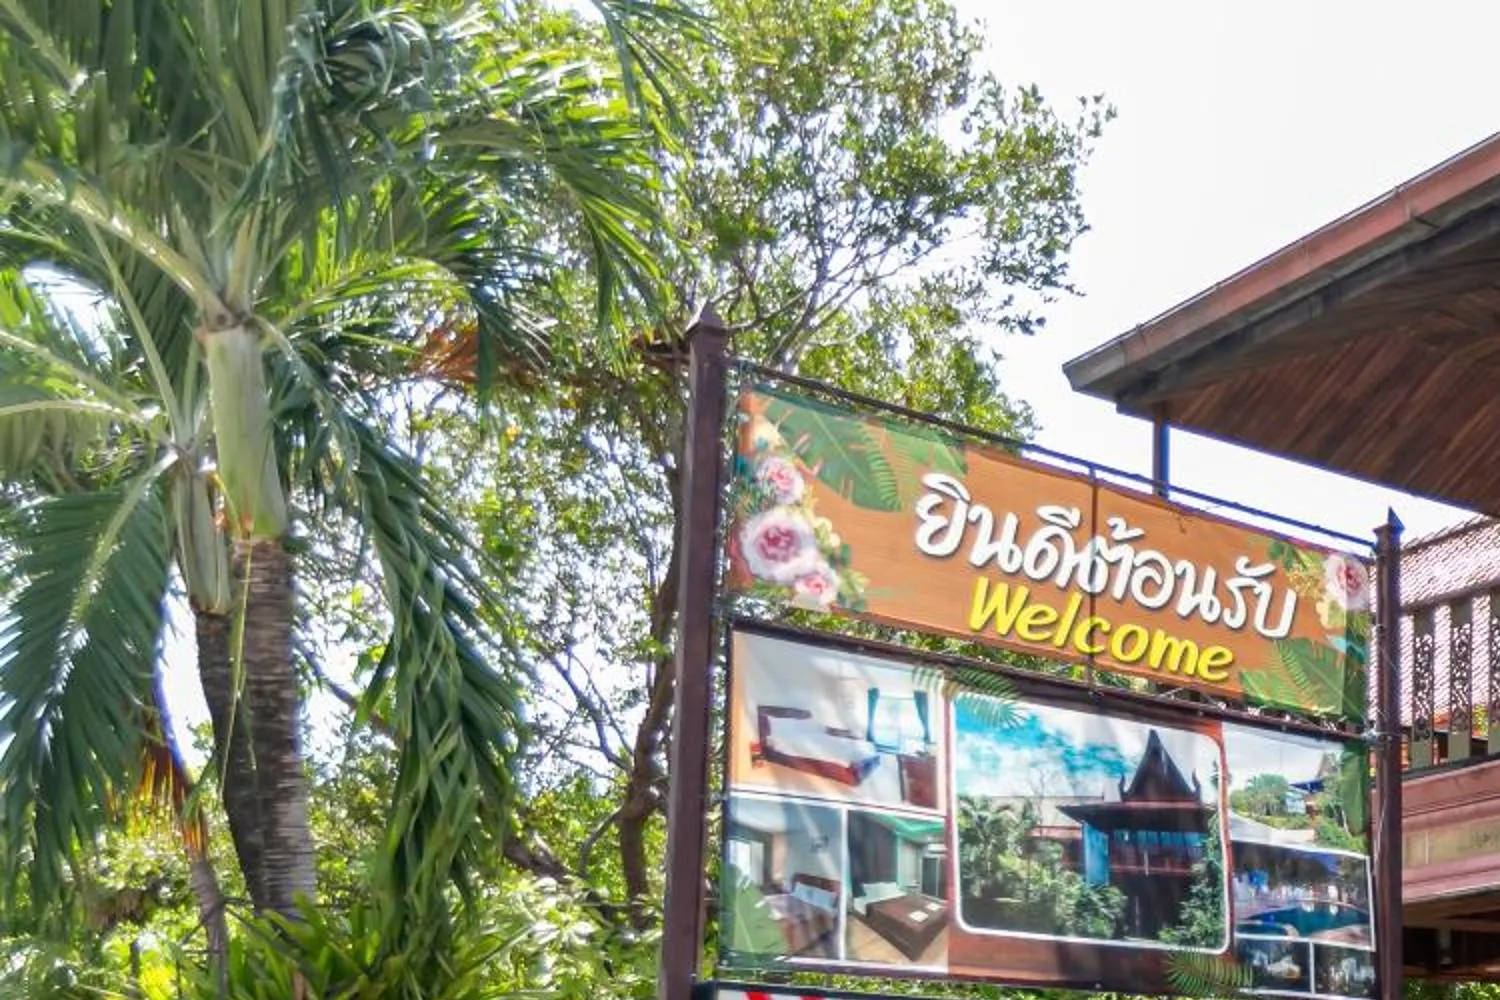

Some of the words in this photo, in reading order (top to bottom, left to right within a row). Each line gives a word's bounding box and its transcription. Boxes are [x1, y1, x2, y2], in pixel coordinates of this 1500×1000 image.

[914, 472, 1297, 639] ยินดีต้อนรับ
[968, 575, 1235, 681] Welcome
